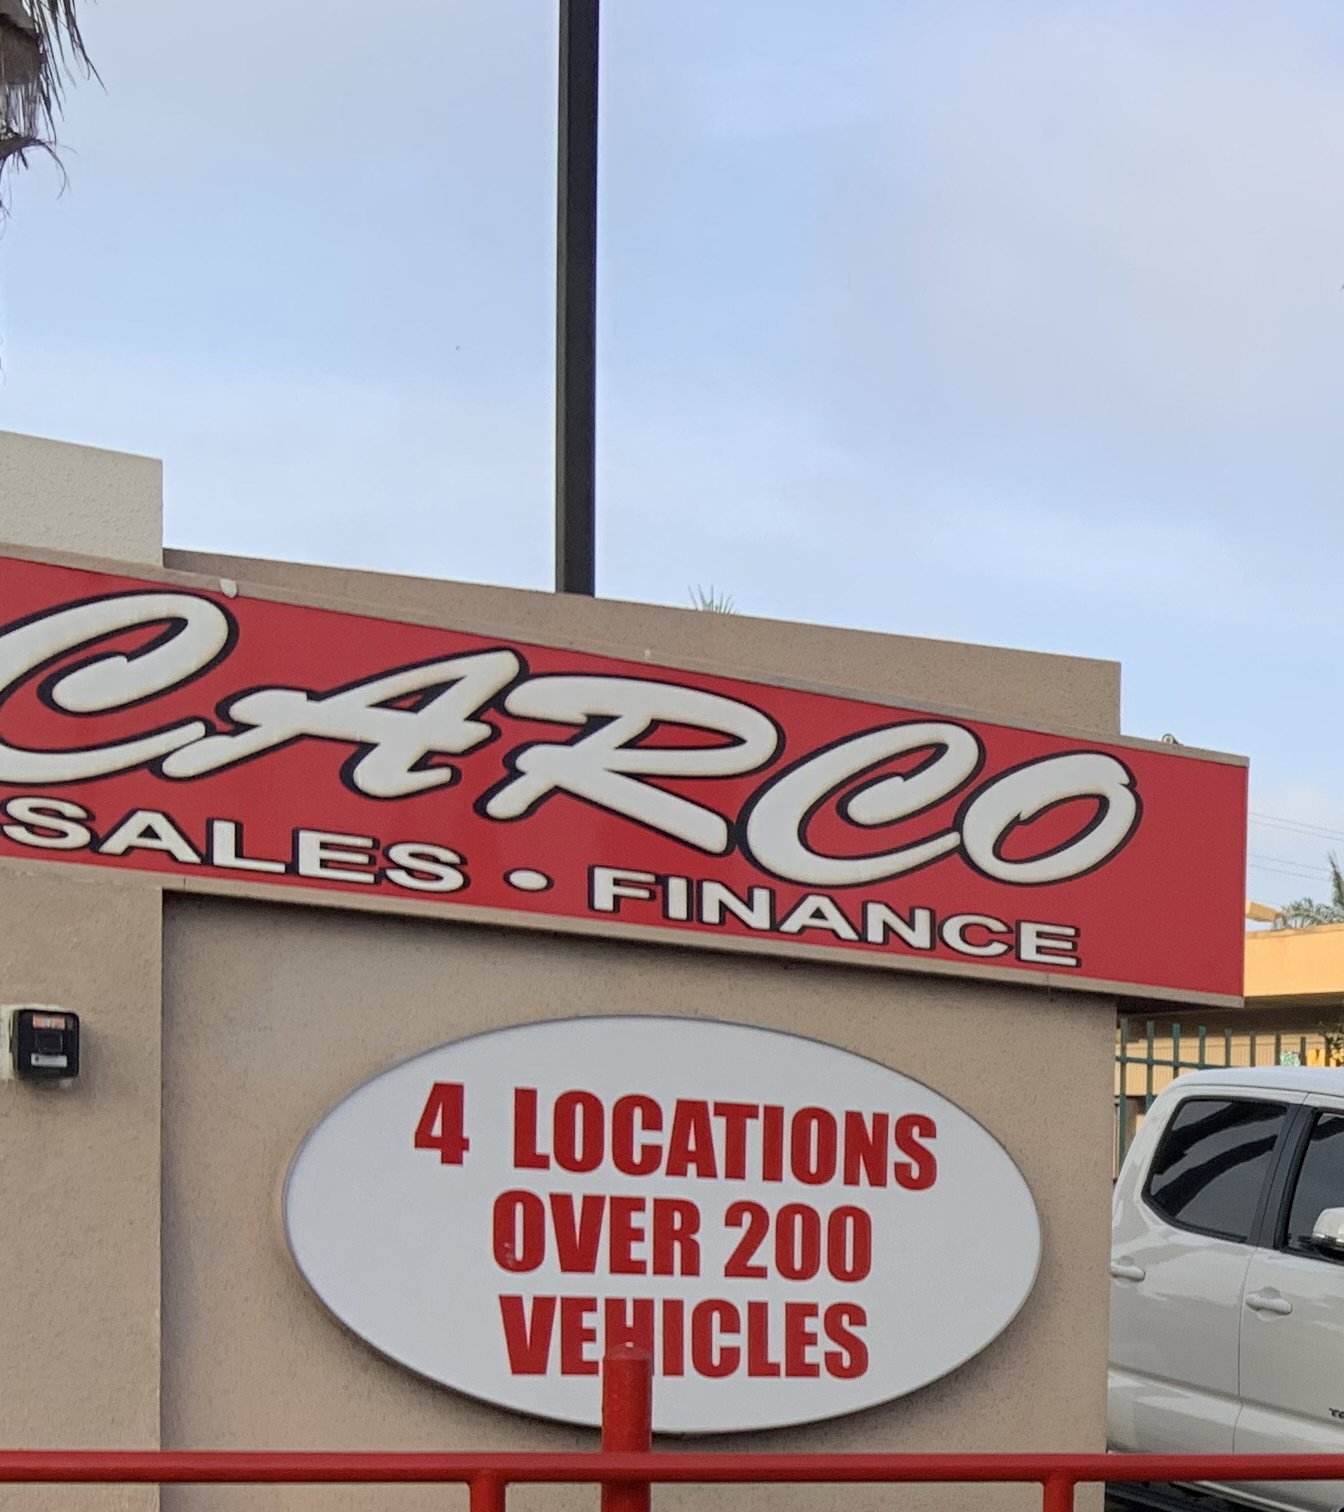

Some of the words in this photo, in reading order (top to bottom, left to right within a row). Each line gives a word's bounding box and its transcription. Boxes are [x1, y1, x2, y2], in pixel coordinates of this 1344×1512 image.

[0, 592, 1138, 884] CARCO
[3, 796, 466, 894] SALES
[592, 866, 1079, 968] FINANCE
[414, 1082, 470, 1166] 4
[513, 1087, 938, 1191] LOCATIONS
[492, 1190, 701, 1279] OVER
[723, 1200, 873, 1283] 200
[499, 1295, 870, 1380] VEHICLES
